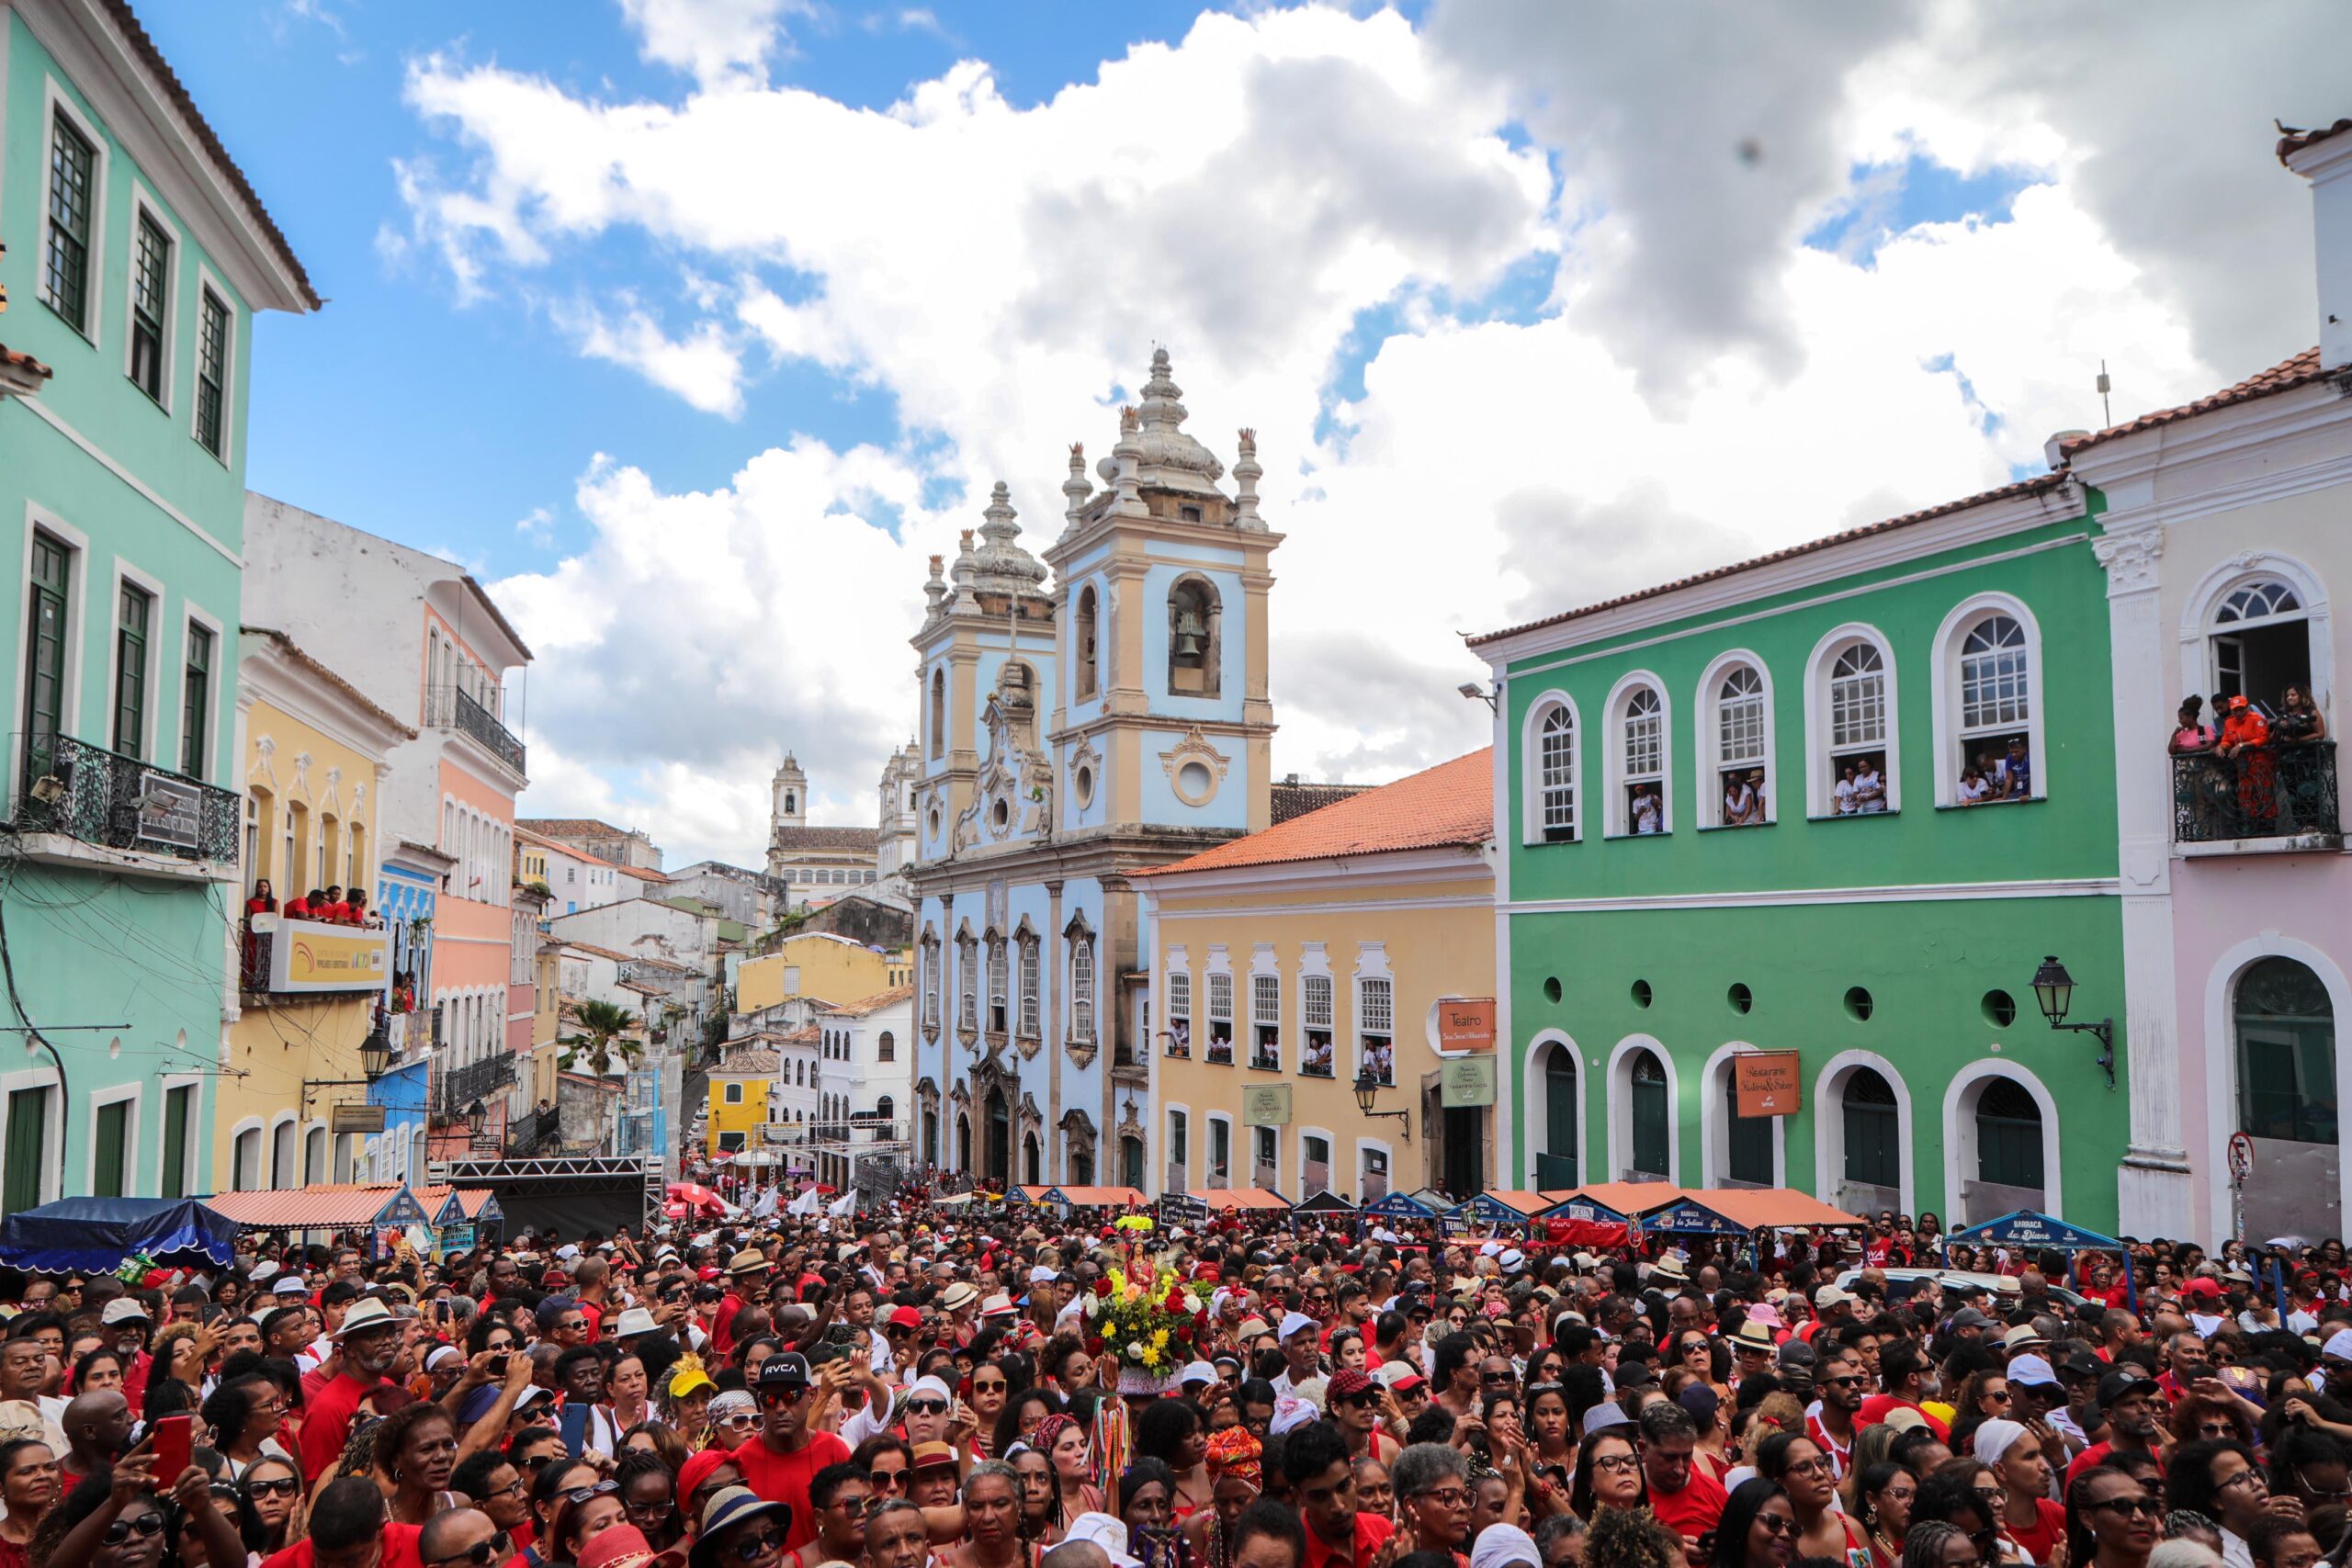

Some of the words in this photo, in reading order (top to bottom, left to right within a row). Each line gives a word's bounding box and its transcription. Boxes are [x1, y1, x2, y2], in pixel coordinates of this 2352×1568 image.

[1449, 1013, 1481, 1027] Teatro
[1746, 1066, 1787, 1077] Restaurante
[2013, 1220, 2042, 1229] BARRACA
[2007, 1230, 2020, 1239] da
[2021, 1229, 2051, 1241] Diane
[765, 1364, 797, 1375] RVCA
